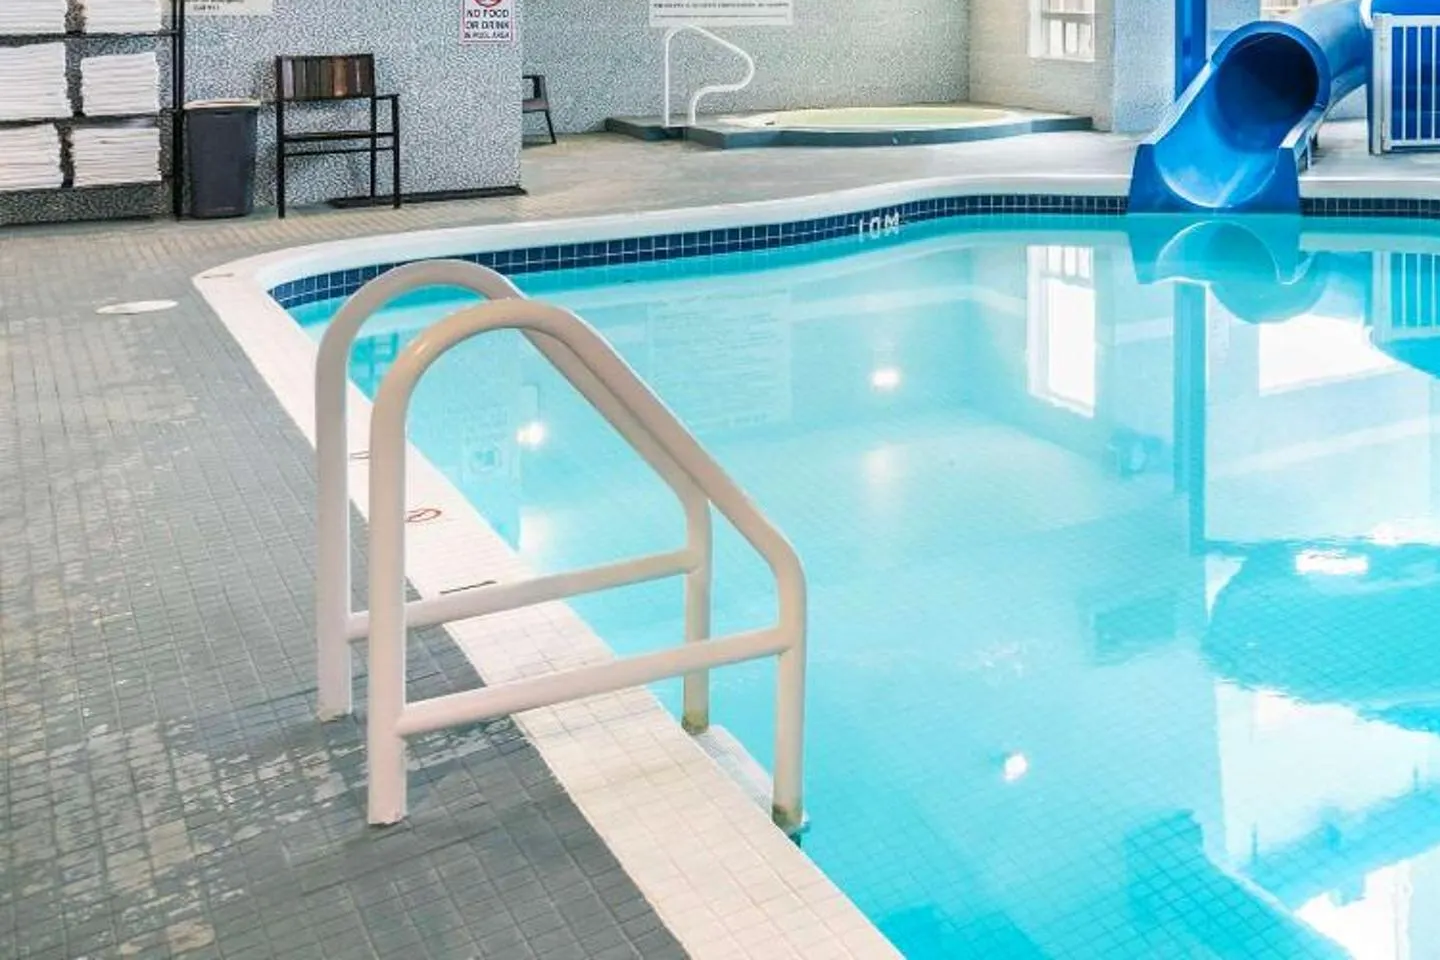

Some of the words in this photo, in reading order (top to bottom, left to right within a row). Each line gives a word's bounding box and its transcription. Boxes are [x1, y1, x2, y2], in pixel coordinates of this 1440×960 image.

[467, 9, 481, 18] NO
[483, 9, 510, 18] FOOD
[466, 21, 480, 29] OR
[482, 21, 510, 29] DRINK
